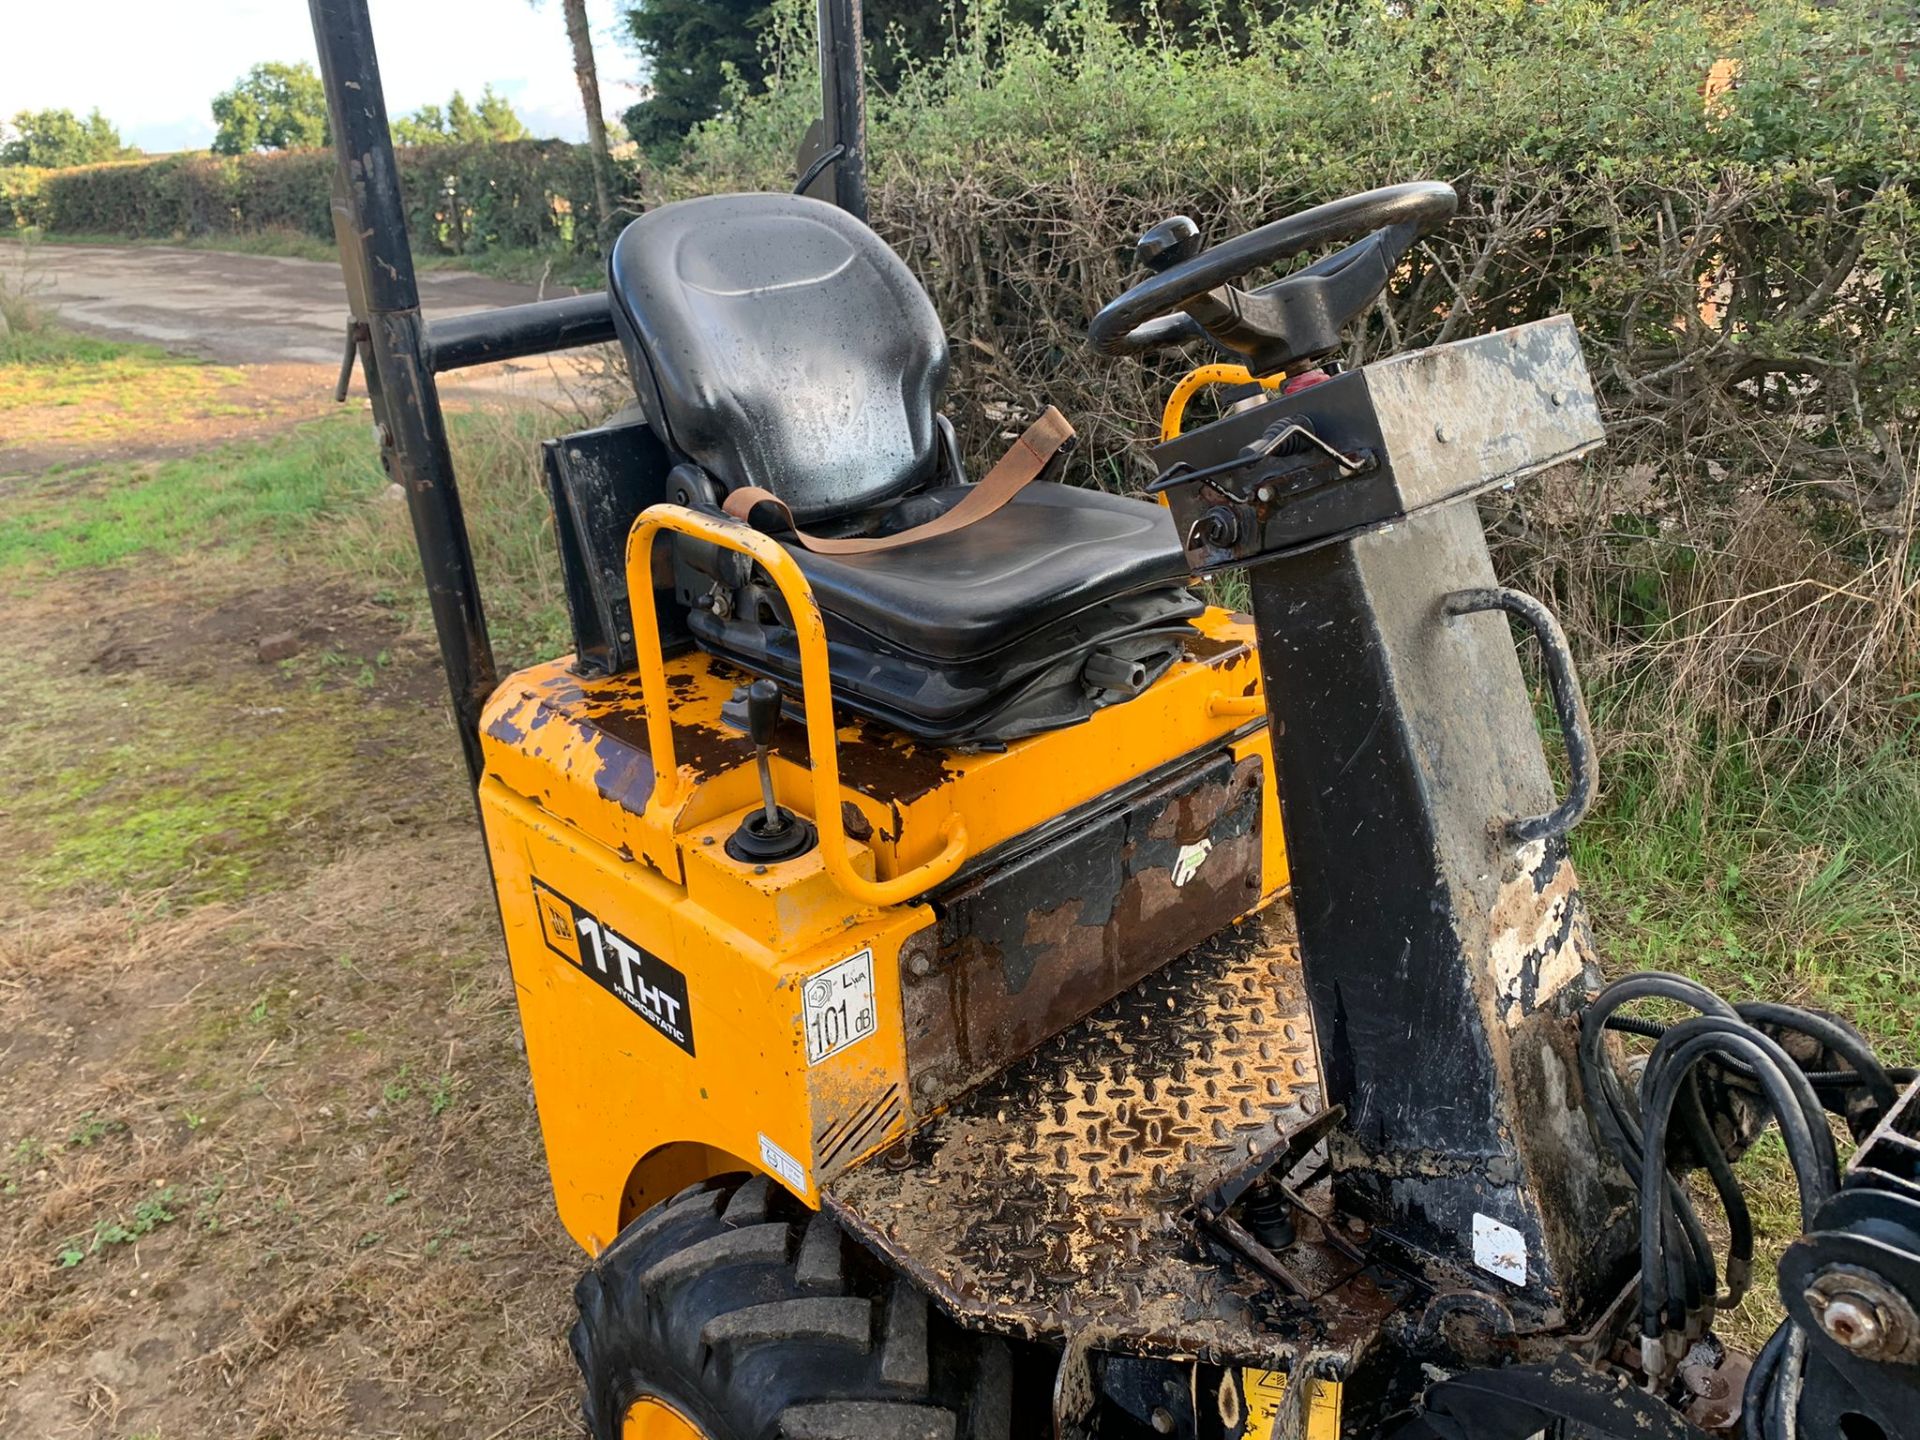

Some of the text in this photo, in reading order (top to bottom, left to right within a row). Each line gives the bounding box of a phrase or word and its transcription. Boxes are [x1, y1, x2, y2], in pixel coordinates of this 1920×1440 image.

[613, 982, 686, 1043] HYDROSTATIC
[811, 998, 872, 1054] 101 dB
